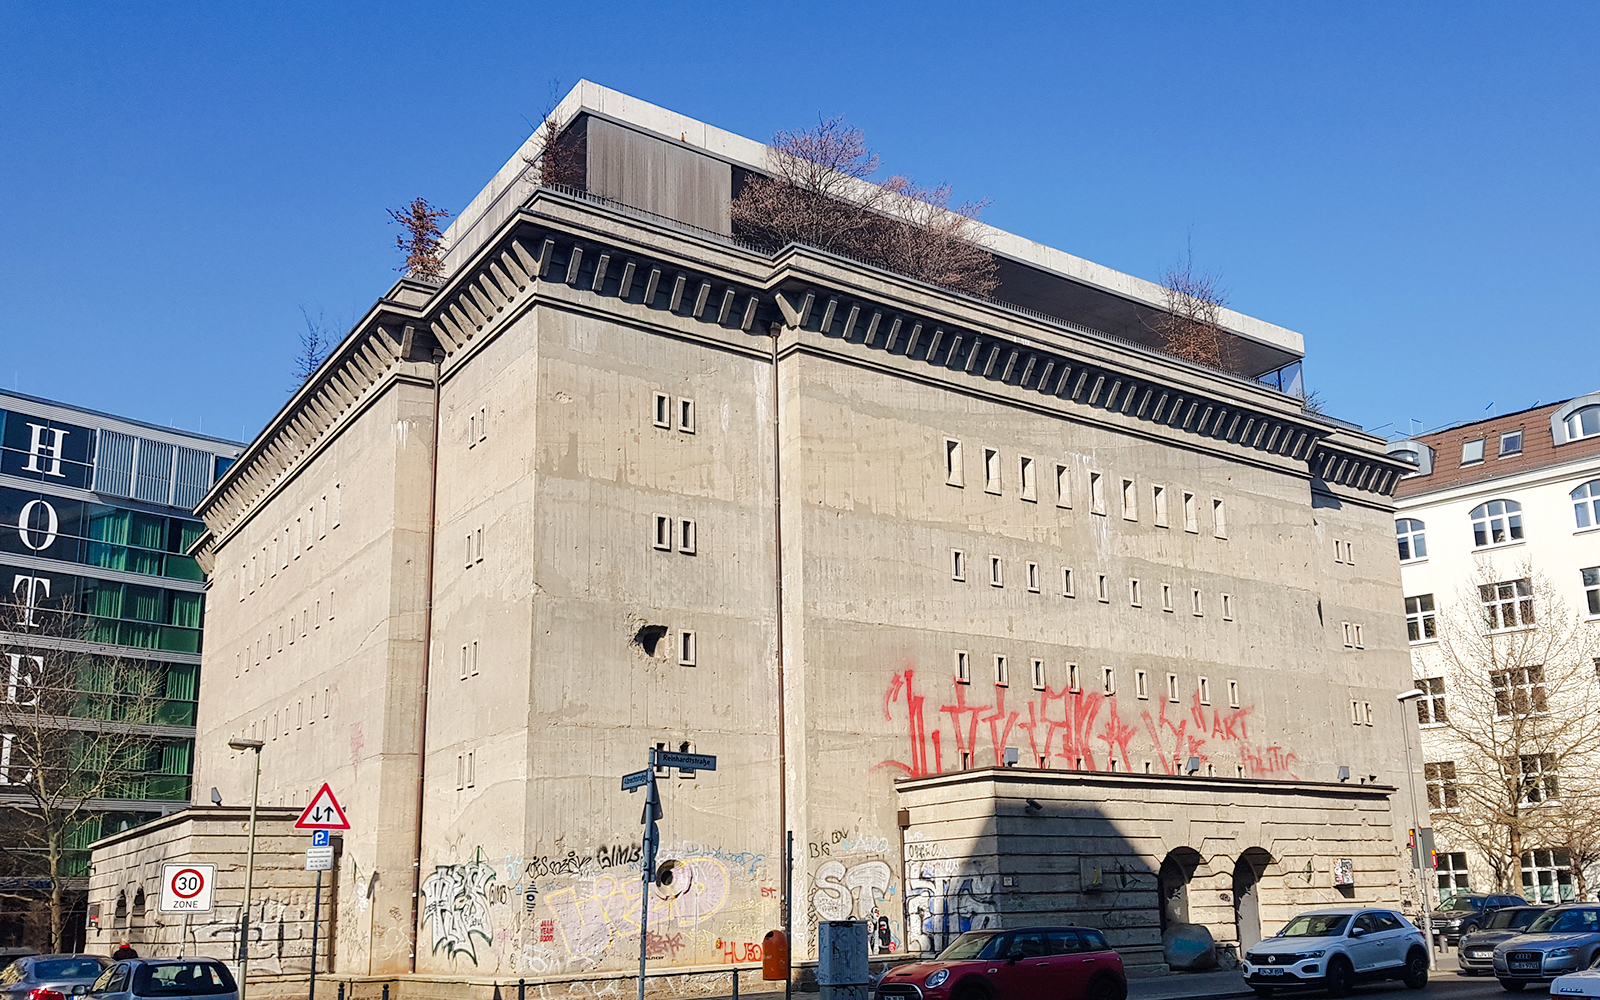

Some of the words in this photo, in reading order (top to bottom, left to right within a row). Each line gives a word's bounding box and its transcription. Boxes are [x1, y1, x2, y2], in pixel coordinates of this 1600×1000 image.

[0, 421, 71, 787] HOTEL
[662, 753, 711, 766] Reinhardtstraße
[314, 831, 325, 845] P
[178, 877, 198, 891] 30
[172, 900, 199, 909] ZONE
